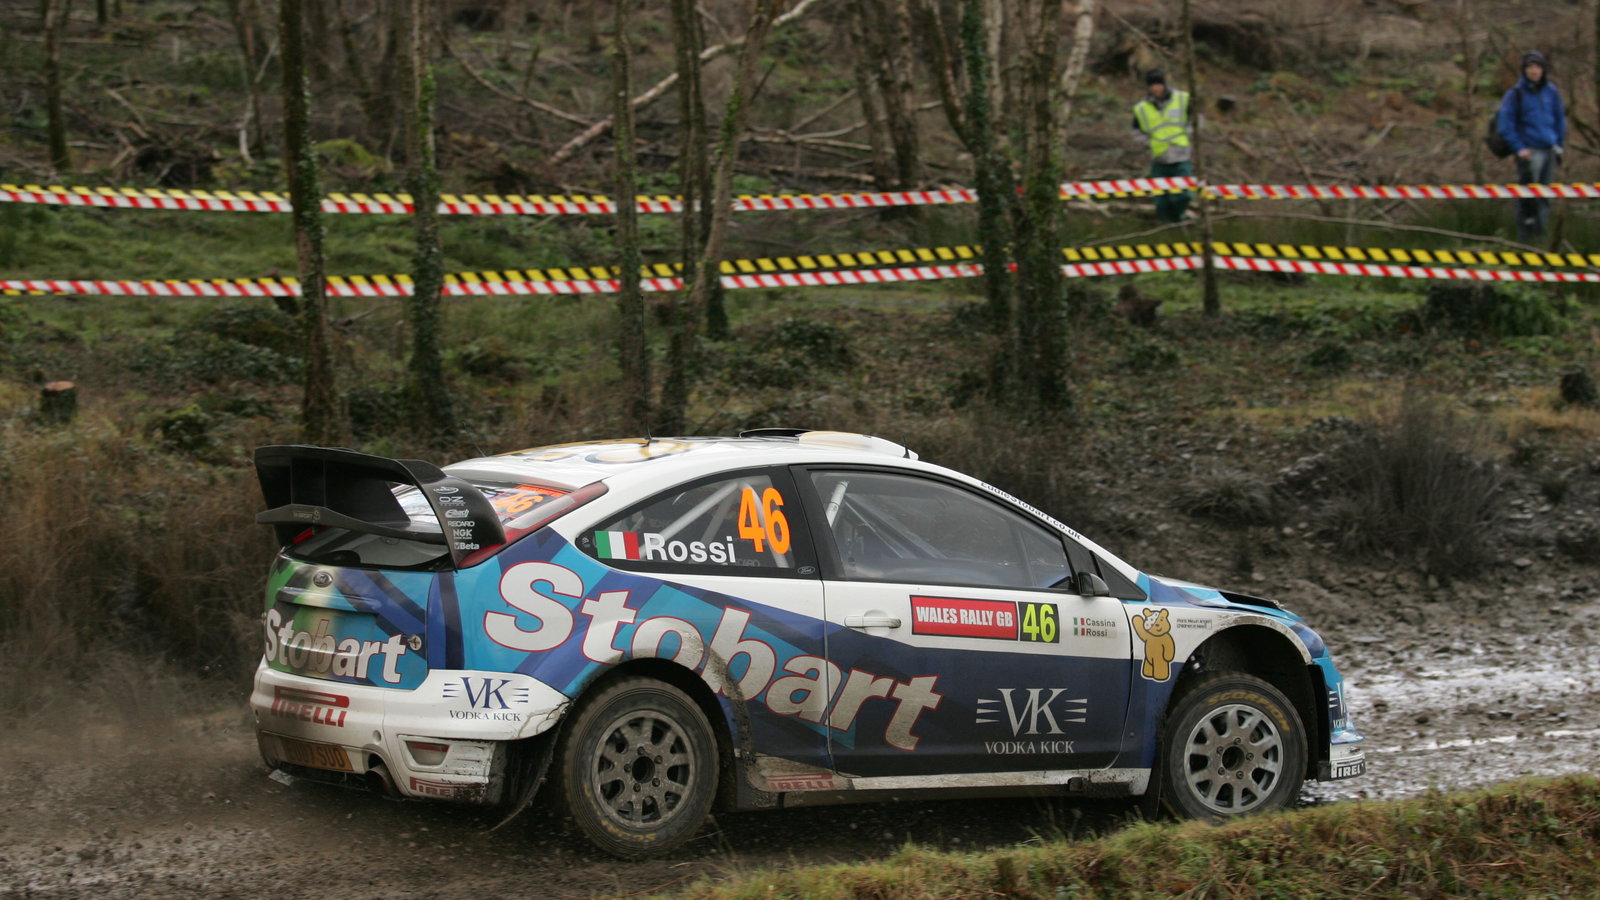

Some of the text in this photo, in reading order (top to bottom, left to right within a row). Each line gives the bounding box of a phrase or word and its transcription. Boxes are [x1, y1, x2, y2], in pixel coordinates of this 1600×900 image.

[453, 529, 473, 537] NGK
[737, 487, 791, 555] 46
[460, 542, 480, 550] Beta
[643, 532, 737, 563] Rossi
[916, 606, 1014, 627] WALES RALLY GB
[1023, 603, 1056, 643] 46
[1085, 618, 1116, 628] Cassina
[264, 607, 407, 684] Stobart
[1086, 628, 1108, 637] Rossi
[483, 560, 944, 751] Stobart
[271, 686, 350, 728] PIRELLI
[461, 676, 513, 710] VK
[449, 710, 522, 722] VODKA KICK
[997, 688, 1068, 736] VK
[985, 740, 1075, 754] VODKA KICK
